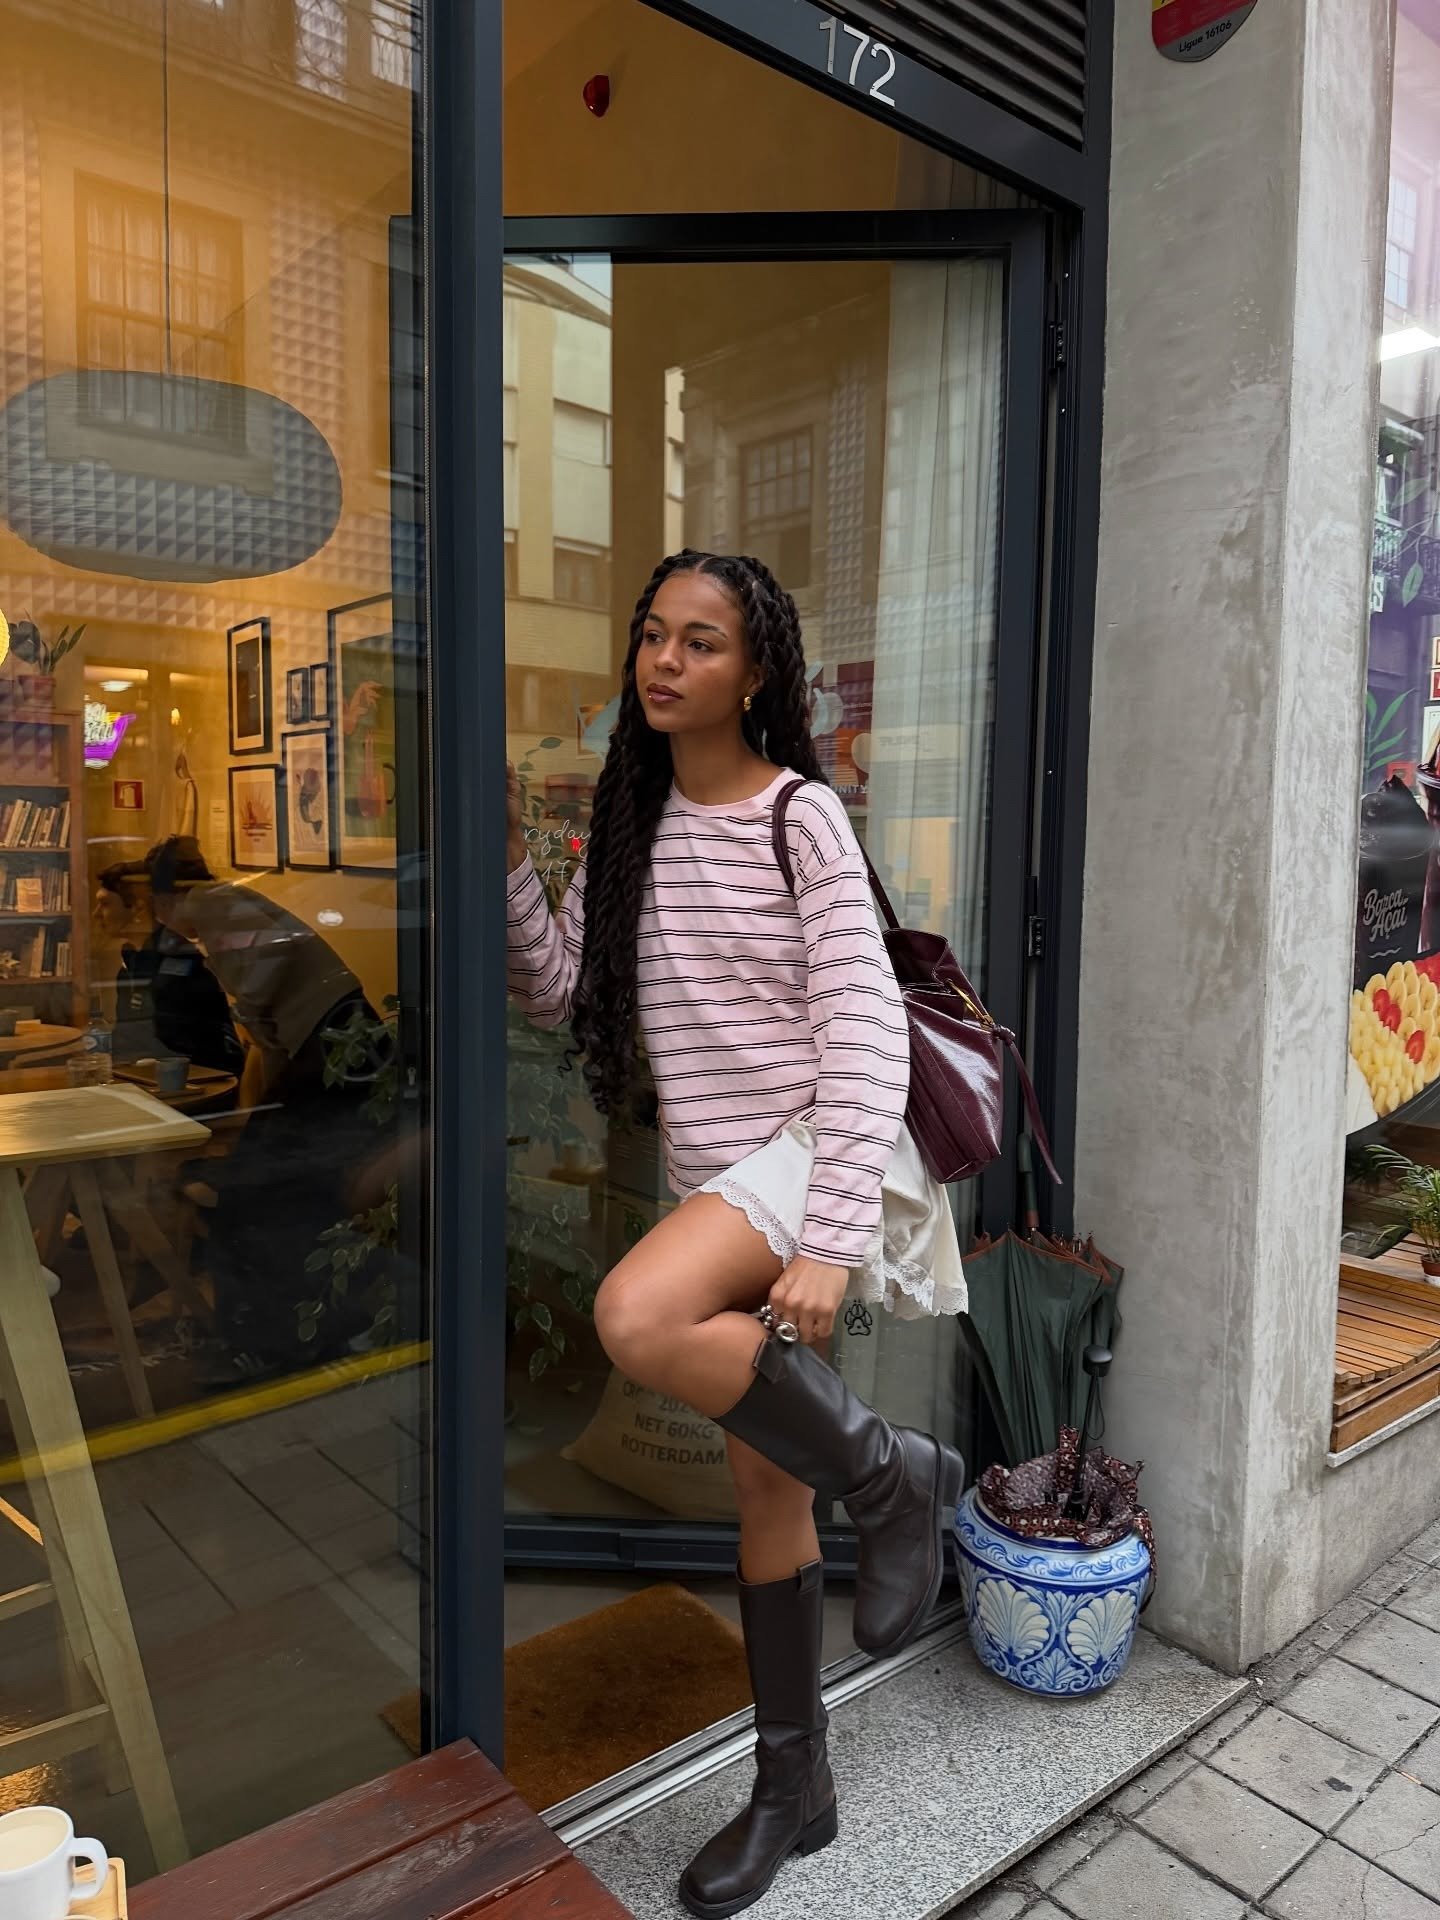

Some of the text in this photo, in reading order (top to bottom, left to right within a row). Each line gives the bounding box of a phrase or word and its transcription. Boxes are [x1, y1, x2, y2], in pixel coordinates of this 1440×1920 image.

[1179, 20, 1232, 53] Ligue 16106
[819, 16, 895, 107] 172
[634, 1413, 717, 1440] NET 60KG
[621, 1432, 725, 1465] ROTTERDAM
